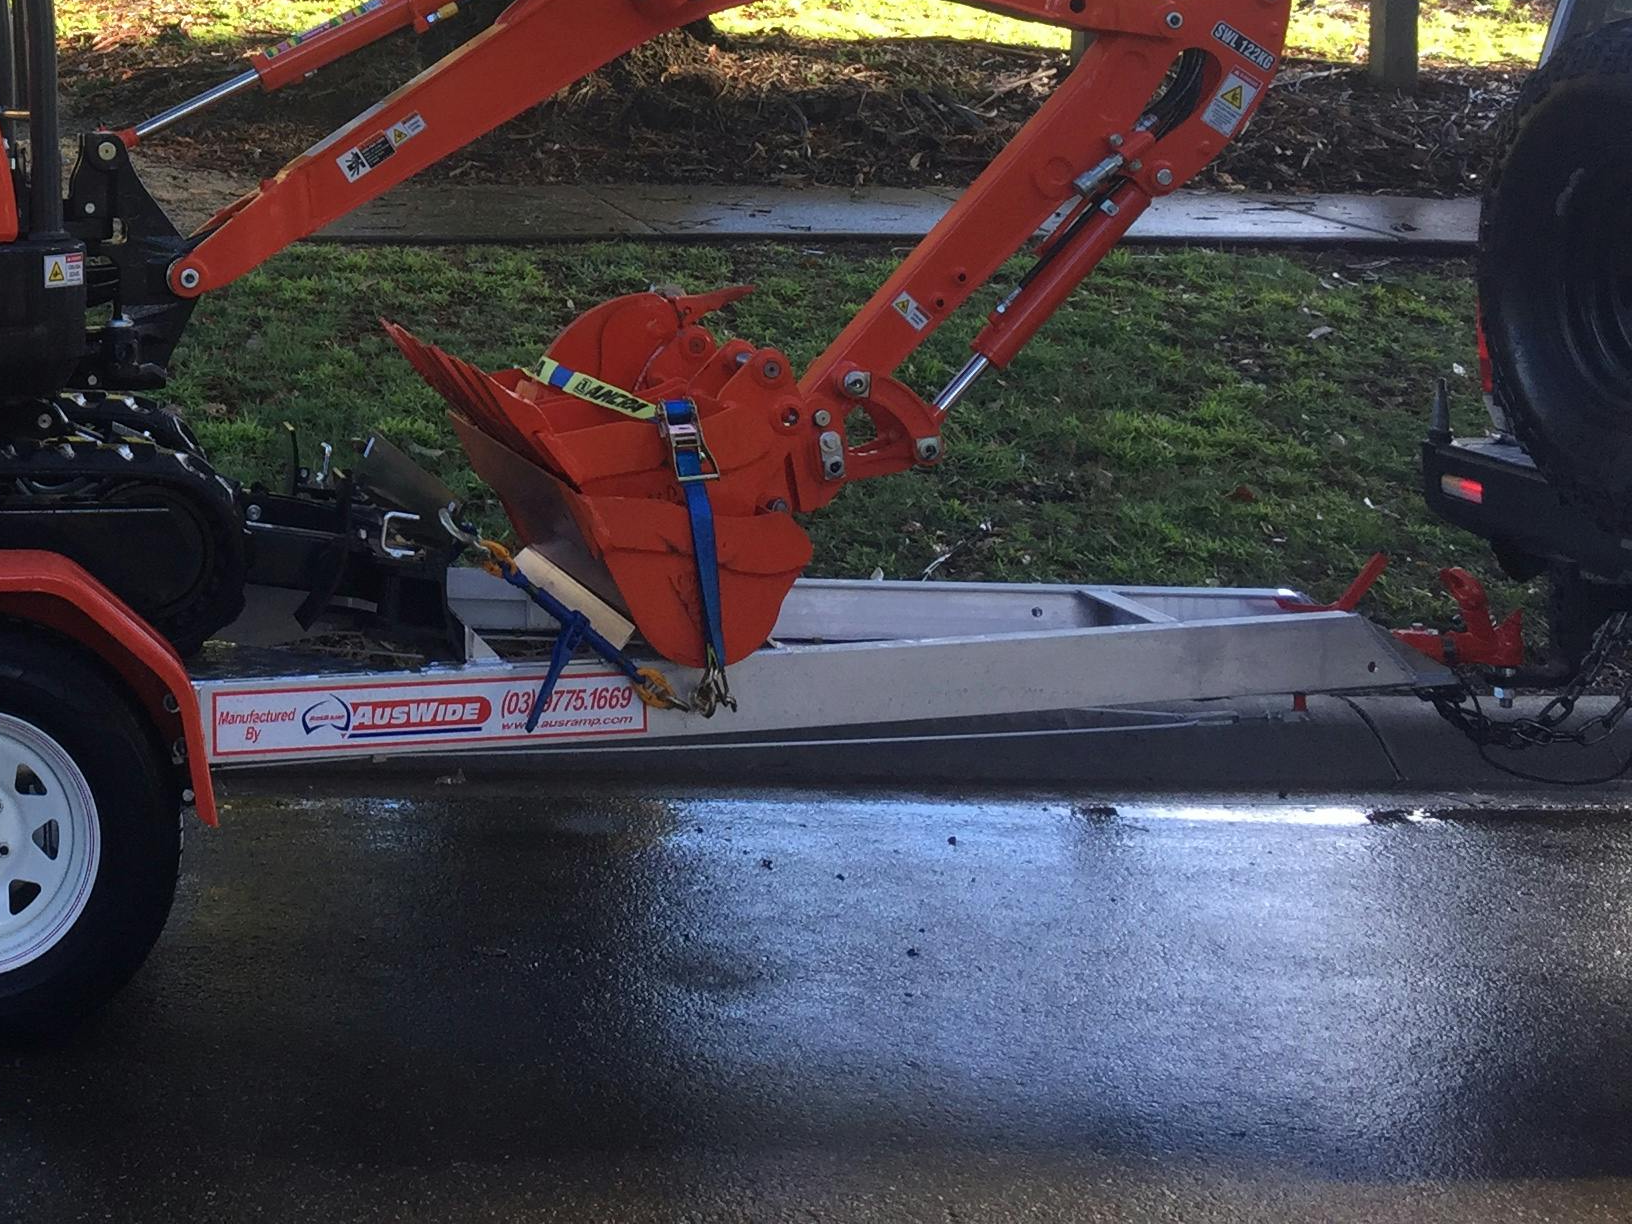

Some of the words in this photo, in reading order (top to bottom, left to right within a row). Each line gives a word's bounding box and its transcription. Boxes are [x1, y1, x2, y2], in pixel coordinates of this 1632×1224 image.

[1214, 23, 1240, 48] SWL
[1239, 40, 1274, 70] 122KG
[218, 707, 297, 725] Manufactured
[501, 716, 633, 730] ww.ausramp.com
[244, 726, 262, 743] By
